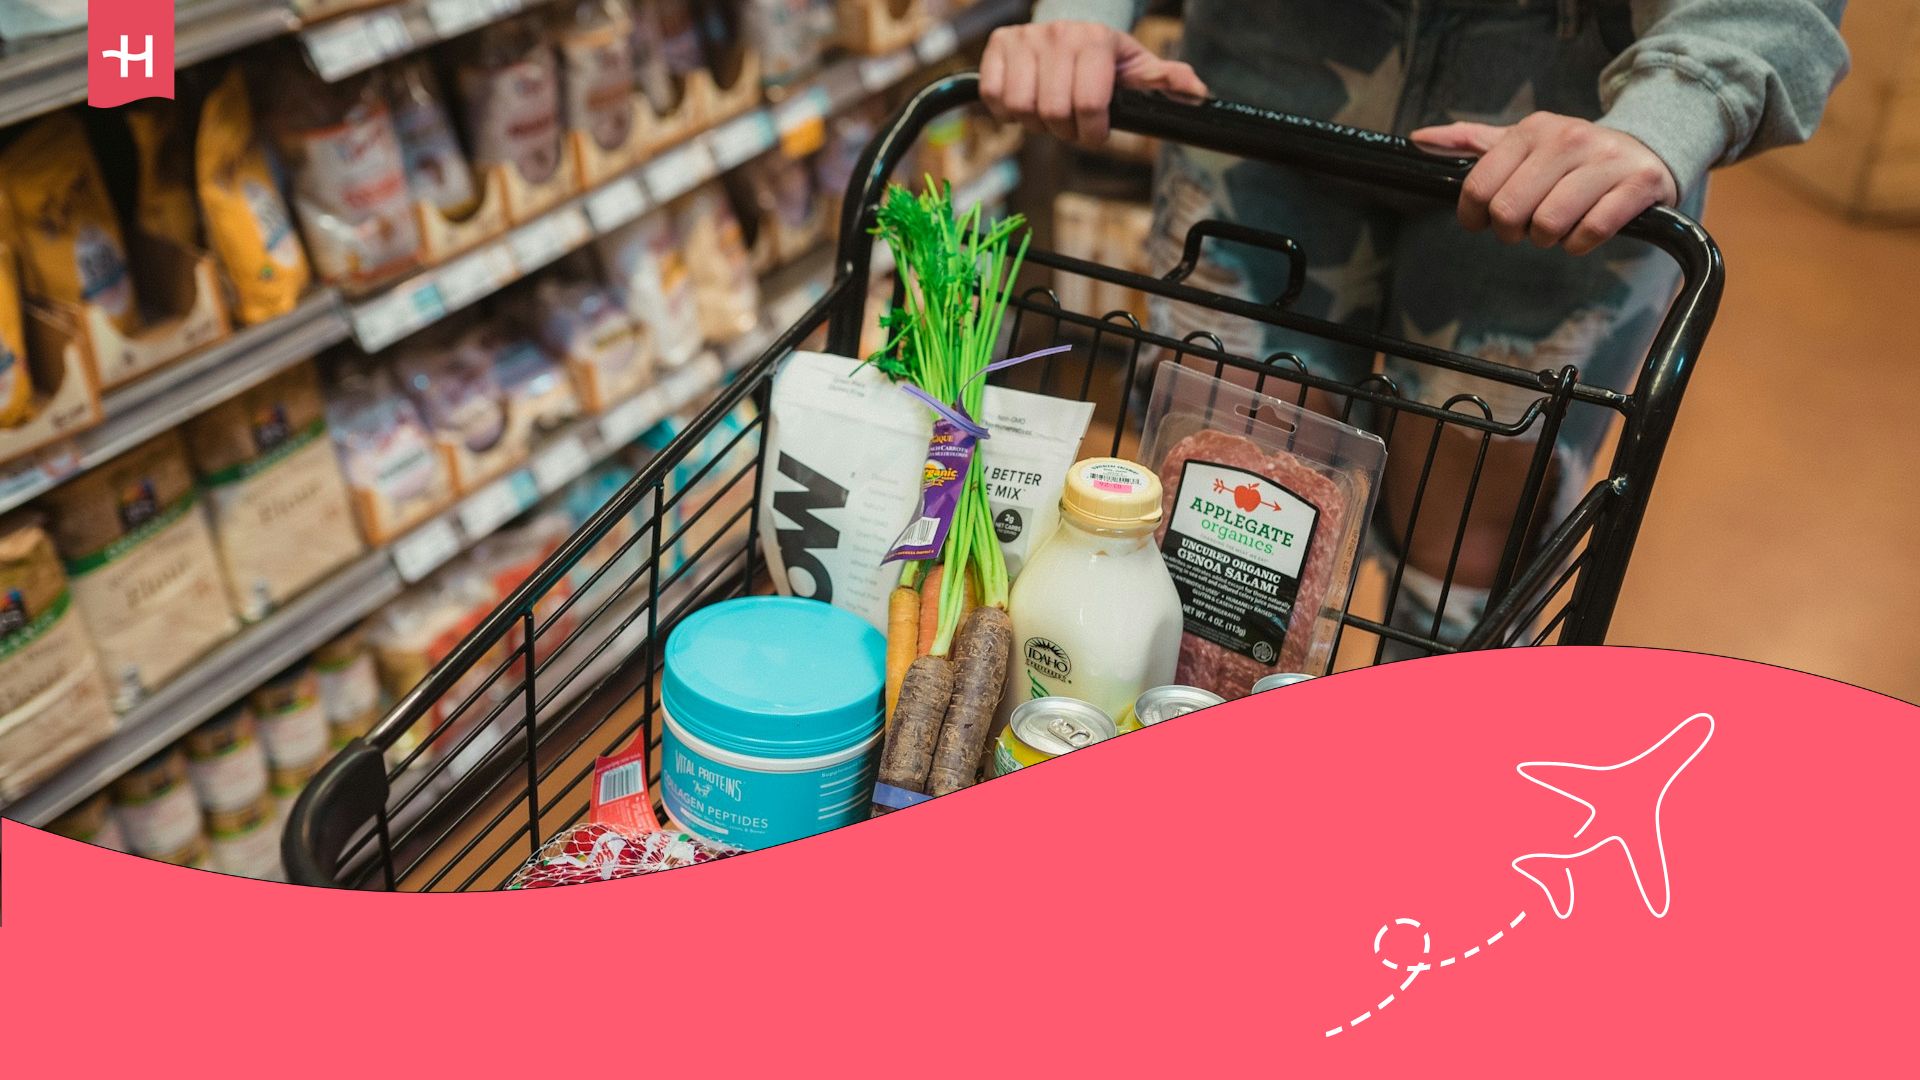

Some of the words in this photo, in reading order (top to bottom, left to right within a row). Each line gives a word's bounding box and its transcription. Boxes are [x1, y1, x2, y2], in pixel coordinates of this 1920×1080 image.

[991, 467, 1042, 486] BETTER
[994, 485, 1022, 501] MIX
[1005, 513, 1015, 525] 2g
[1190, 497, 1294, 547] APPLEGATE
[1201, 518, 1273, 555] organics
[1175, 547, 1223, 573] GENOA
[1223, 567, 1279, 595] SALAMI
[1180, 538, 1231, 564] UNCURED
[1231, 558, 1281, 583] ORGANIC
[1191, 587, 1212, 600] GLUTEN
[1214, 598, 1234, 609] CASEIN
[1232, 605, 1246, 614] FREE
[1207, 578, 1217, 586] and
[1217, 583, 1238, 595] cultured
[1238, 591, 1254, 602] celery
[1254, 598, 1267, 606] juice
[1211, 574, 1227, 584] added
[1226, 580, 1244, 591] except
[1266, 596, 1290, 610] naturally
[1224, 595, 1253, 610] HUMANELY
[1181, 604, 1195, 615] NET
[1194, 609, 1208, 620] WT.
[1207, 614, 1214, 622] 4
[1212, 617, 1225, 627] OZ.
[1223, 622, 1247, 637] (113g)
[1191, 598, 1205, 607] KEEP
[1203, 602, 1241, 621] REFRIGERATED
[1028, 647, 1067, 672] IDAHO
[675, 749, 695, 776] VITAL
[698, 766, 743, 802] PROTEINS
[663, 769, 704, 813] COLLAGEN
[707, 806, 769, 829] PEPTIDES
